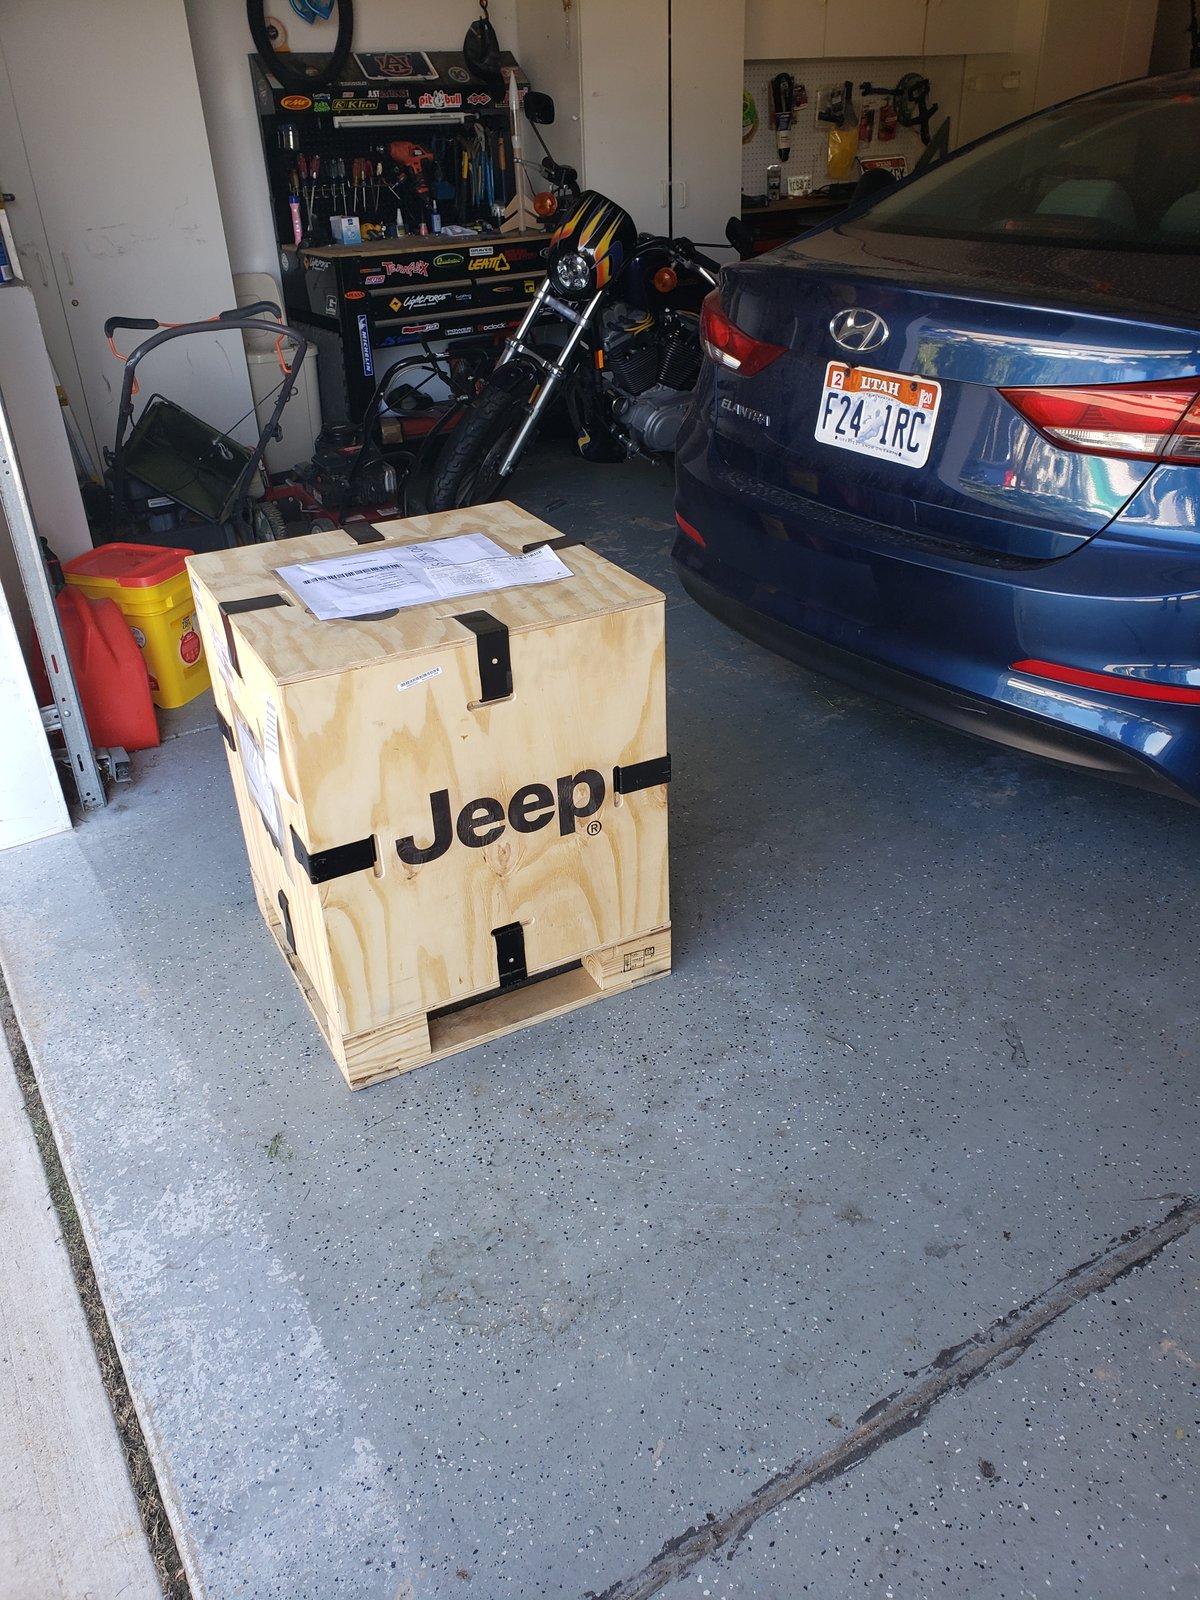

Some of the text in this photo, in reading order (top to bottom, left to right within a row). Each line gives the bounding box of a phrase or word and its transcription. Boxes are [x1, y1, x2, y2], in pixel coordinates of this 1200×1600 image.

[419, 93, 433, 107] pit
[445, 92, 461, 104] bull
[361, 331, 371, 372] MICHELIN
[834, 373, 842, 386] 2
[859, 376, 901, 397] UTAH
[923, 392, 933, 404] 20
[720, 398, 771, 427] ELANTRA
[822, 392, 926, 453] F24 1RC
[395, 769, 606, 865] Jeep
